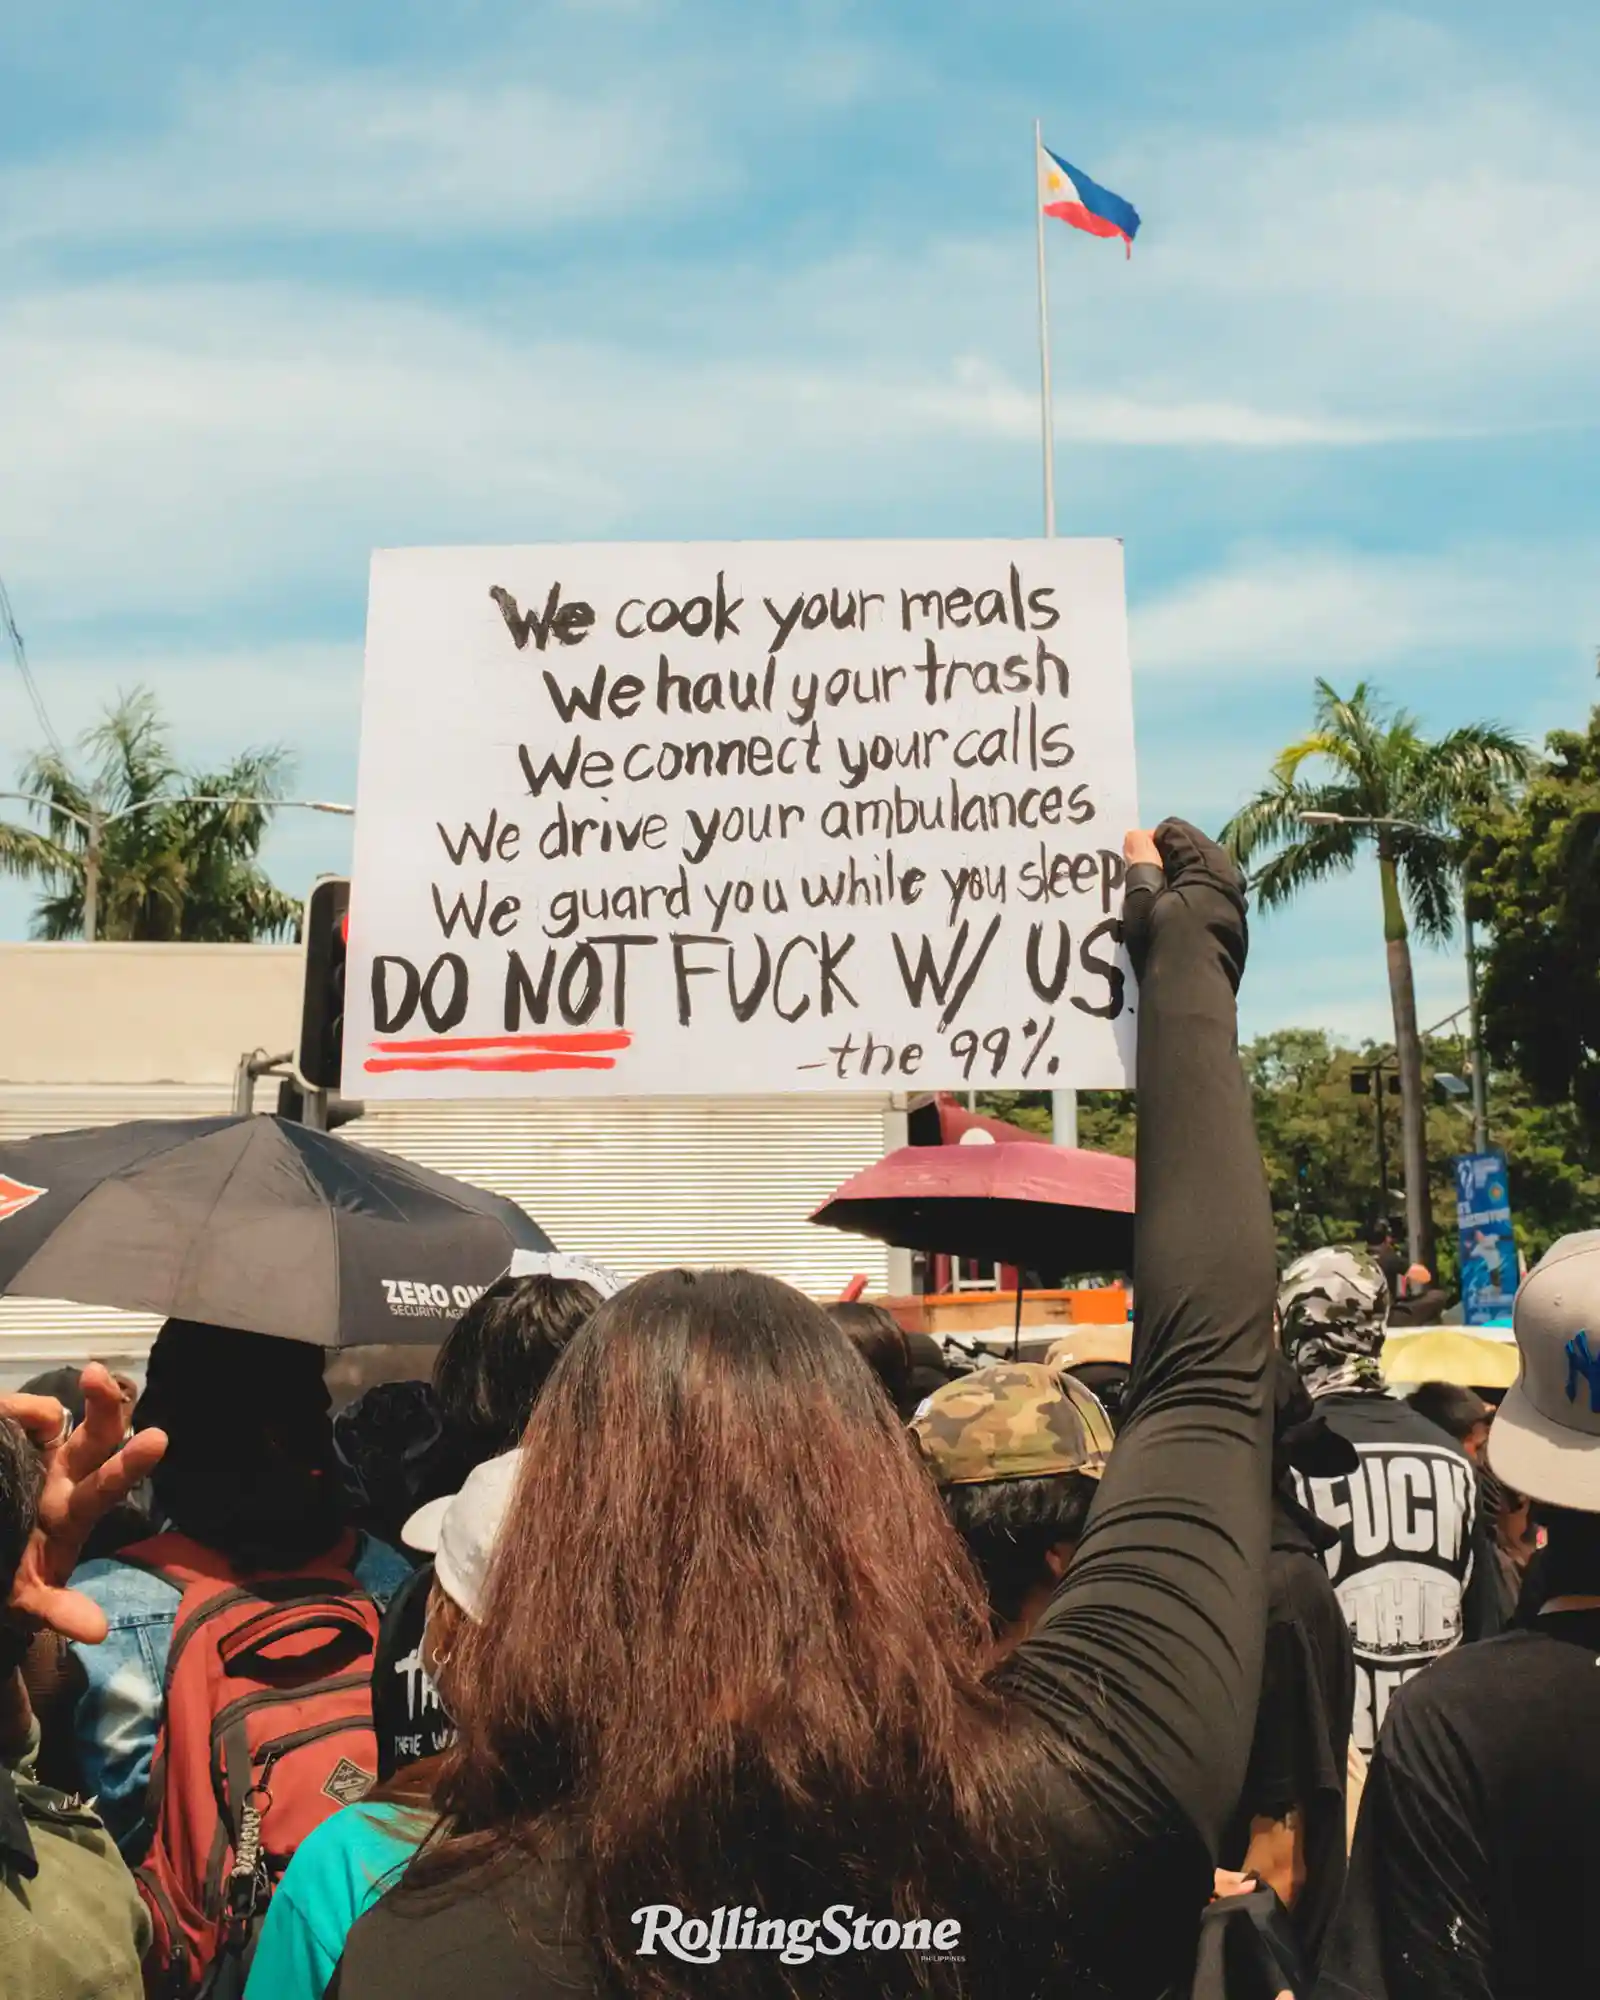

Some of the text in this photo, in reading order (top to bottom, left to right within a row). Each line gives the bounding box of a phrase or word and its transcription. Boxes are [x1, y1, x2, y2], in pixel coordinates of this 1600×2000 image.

[491, 563, 1060, 654] We cook your meals
[543, 639, 1070, 726] We haul your trash
[519, 703, 1075, 798] We connect your calls
[437, 783, 1096, 867] We drive your ambulances
[432, 840, 1126, 947] We guard you while you sleep
[371, 953, 469, 1035] DO
[504, 934, 658, 1033] NOT
[670, 931, 859, 1027] FUCK
[891, 914, 1002, 1035] W/
[381, 1279, 488, 1309] ZERO ON
[389, 1303, 442, 1320] SECURITY
[1342, 1577, 1462, 1649] THE
